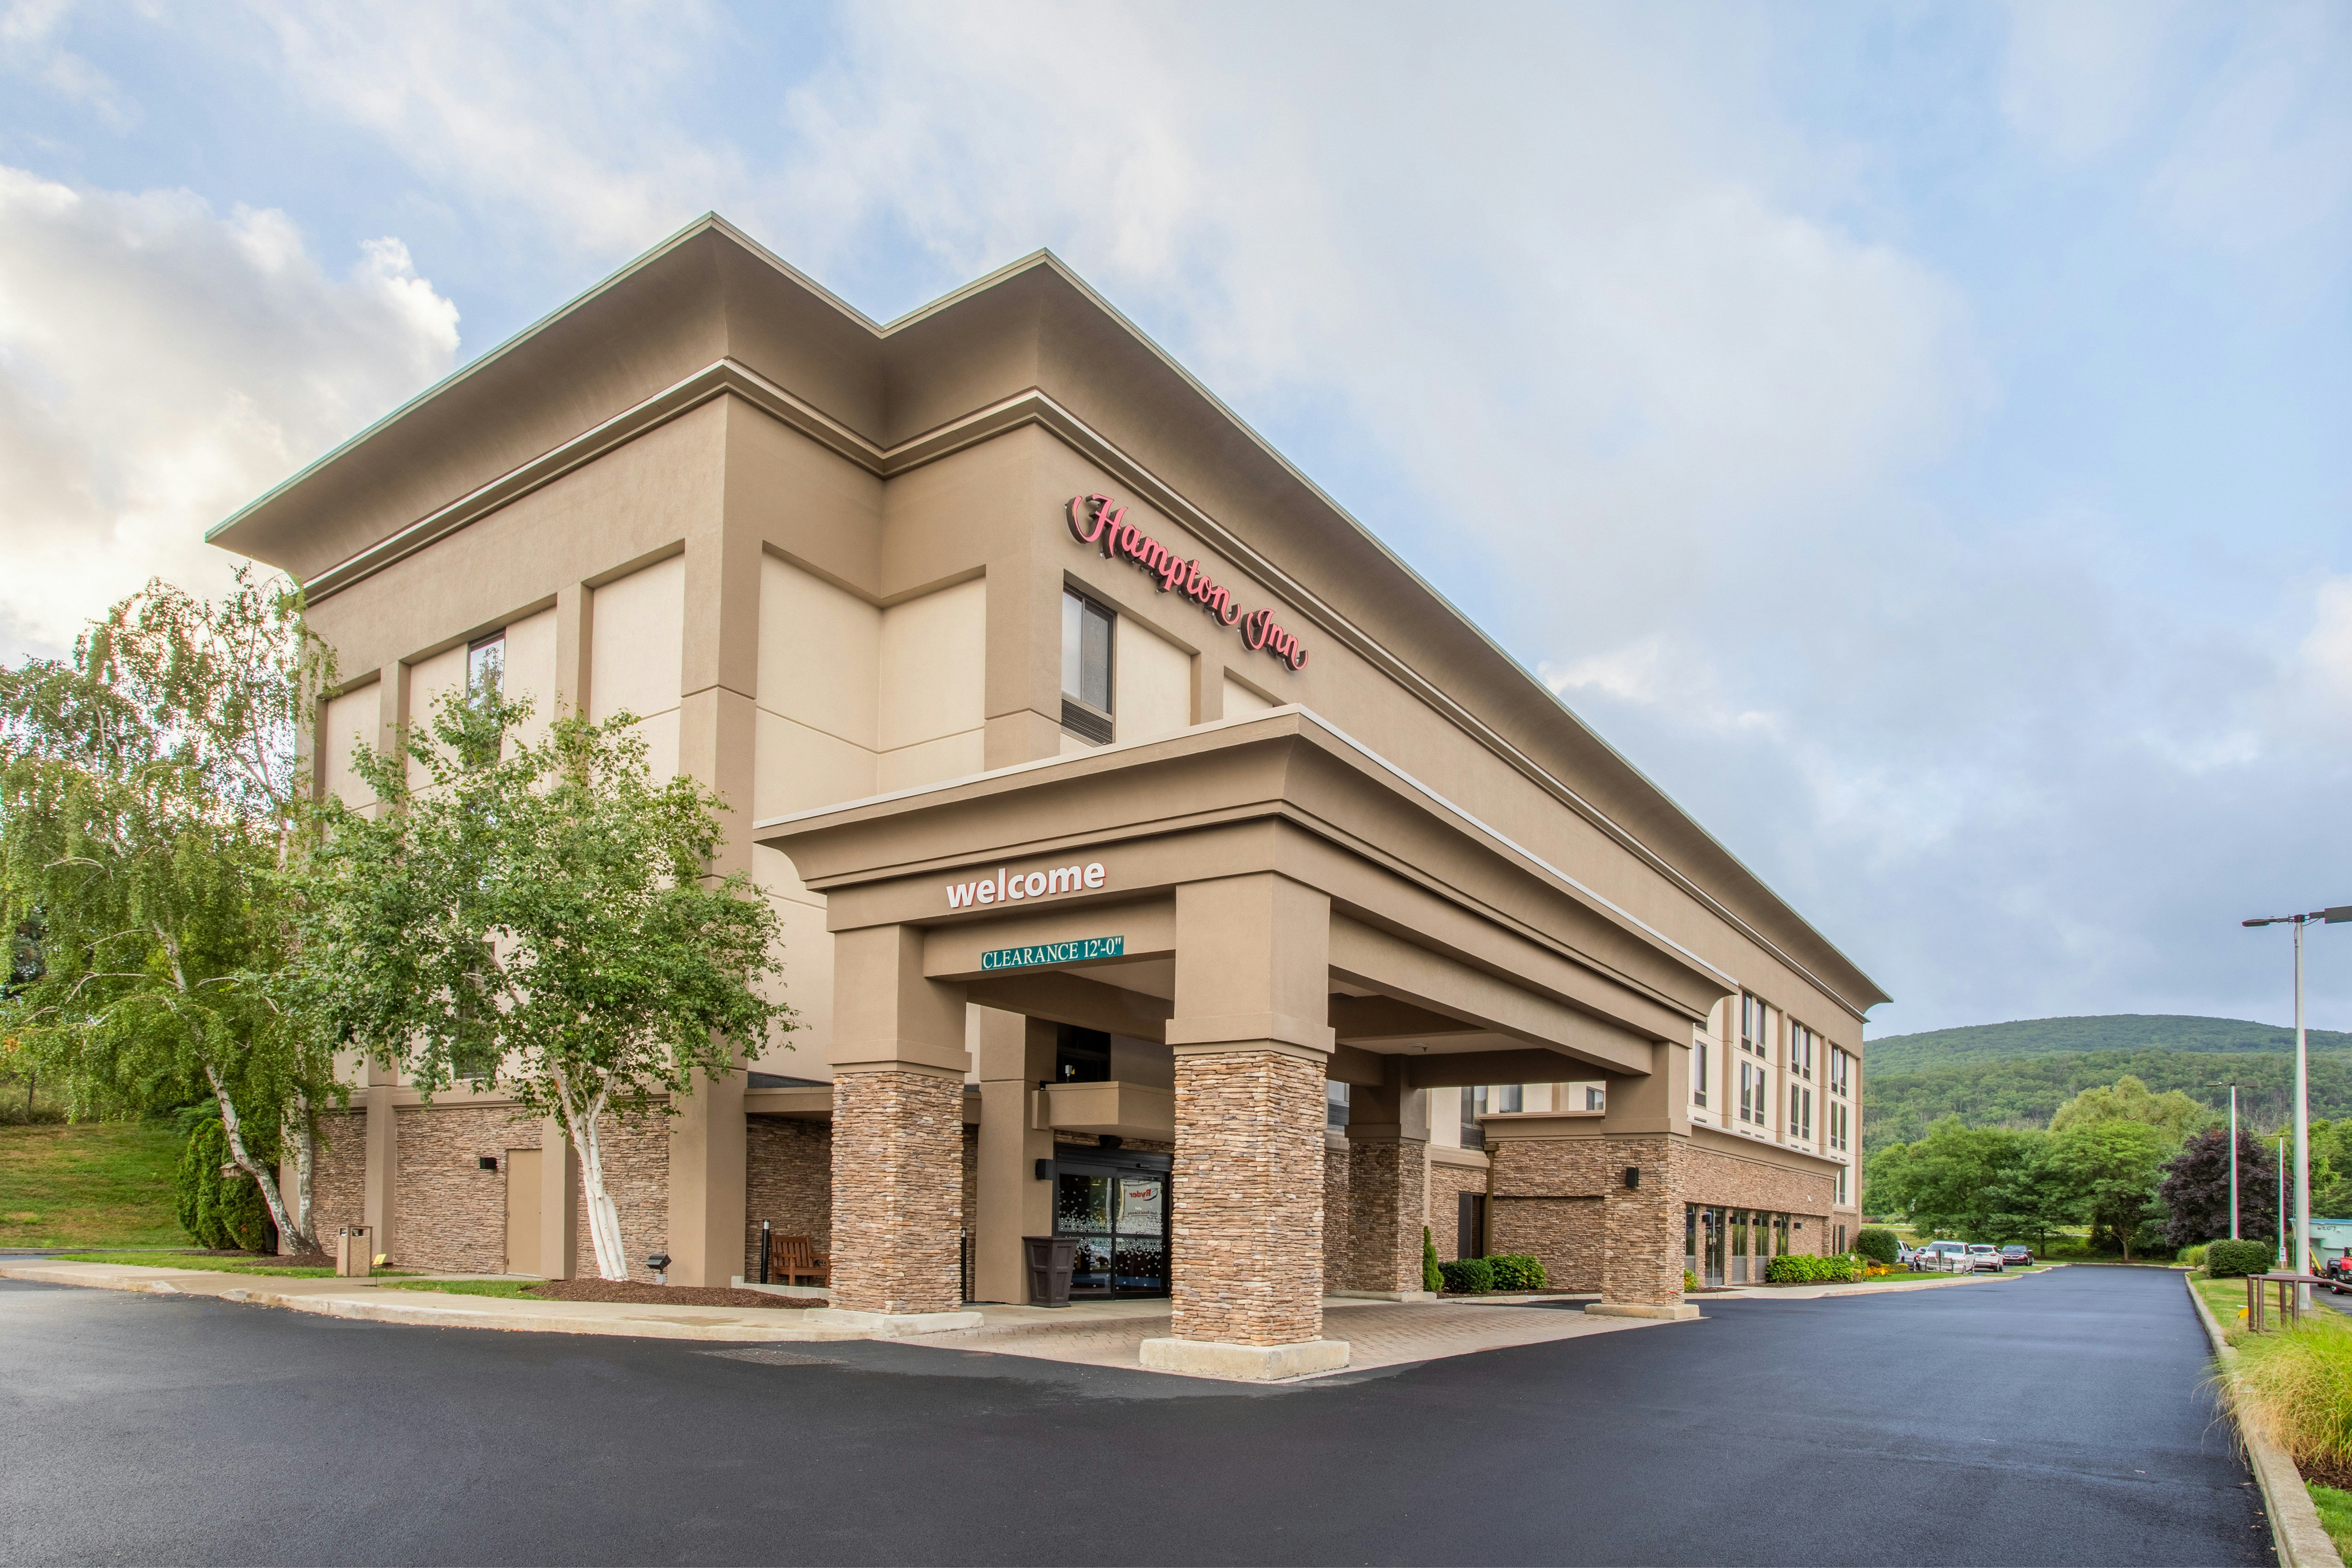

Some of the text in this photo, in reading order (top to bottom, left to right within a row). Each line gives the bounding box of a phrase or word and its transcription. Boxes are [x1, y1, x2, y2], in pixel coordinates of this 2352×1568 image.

[1066, 493, 1308, 671] Hampton Inn
[946, 862, 1105, 908] welcome
[983, 937, 1121, 969] CLEARANCE 12'-0"
